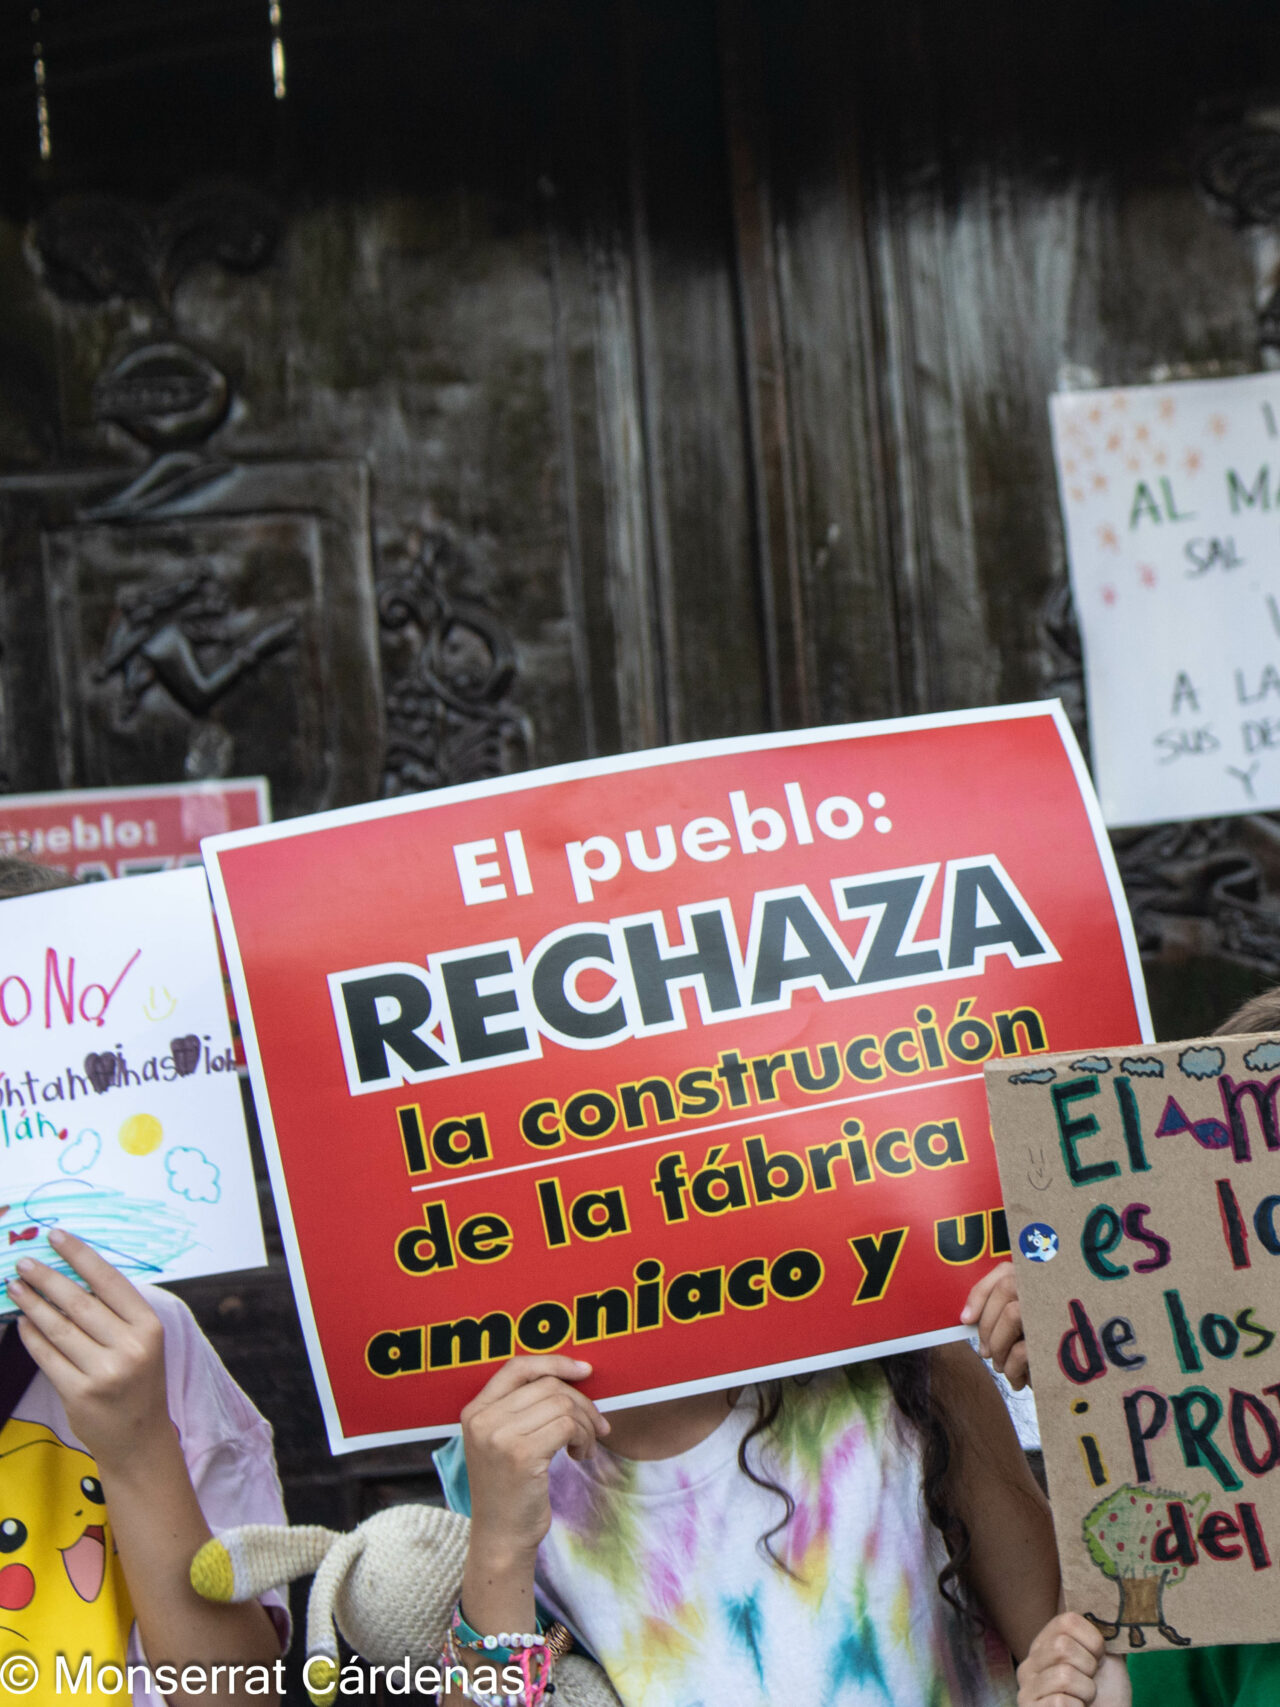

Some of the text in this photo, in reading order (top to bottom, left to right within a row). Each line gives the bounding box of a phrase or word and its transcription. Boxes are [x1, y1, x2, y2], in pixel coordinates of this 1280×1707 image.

[1129, 476, 1196, 530] AL
[1184, 536, 1245, 579] SAL
[1170, 670, 1200, 716] A
[1154, 728, 1220, 765] SUS
[1227, 761, 1260, 800] Y
[453, 781, 893, 906] El pueblo:
[327, 853, 1063, 1097] RECHAZA
[396, 997, 1049, 1176] la construcción
[1051, 1074, 1152, 1187] El
[394, 1202, 513, 1276] de
[537, 1176, 629, 1250] la
[653, 1117, 969, 1224] fábrica
[1080, 1201, 1172, 1281] es
[364, 1246, 825, 1379] amoniaco
[847, 1226, 910, 1306] y
[1057, 1299, 1147, 1386] de
[1163, 1288, 1277, 1374] los
[1150, 1500, 1273, 1571] del
